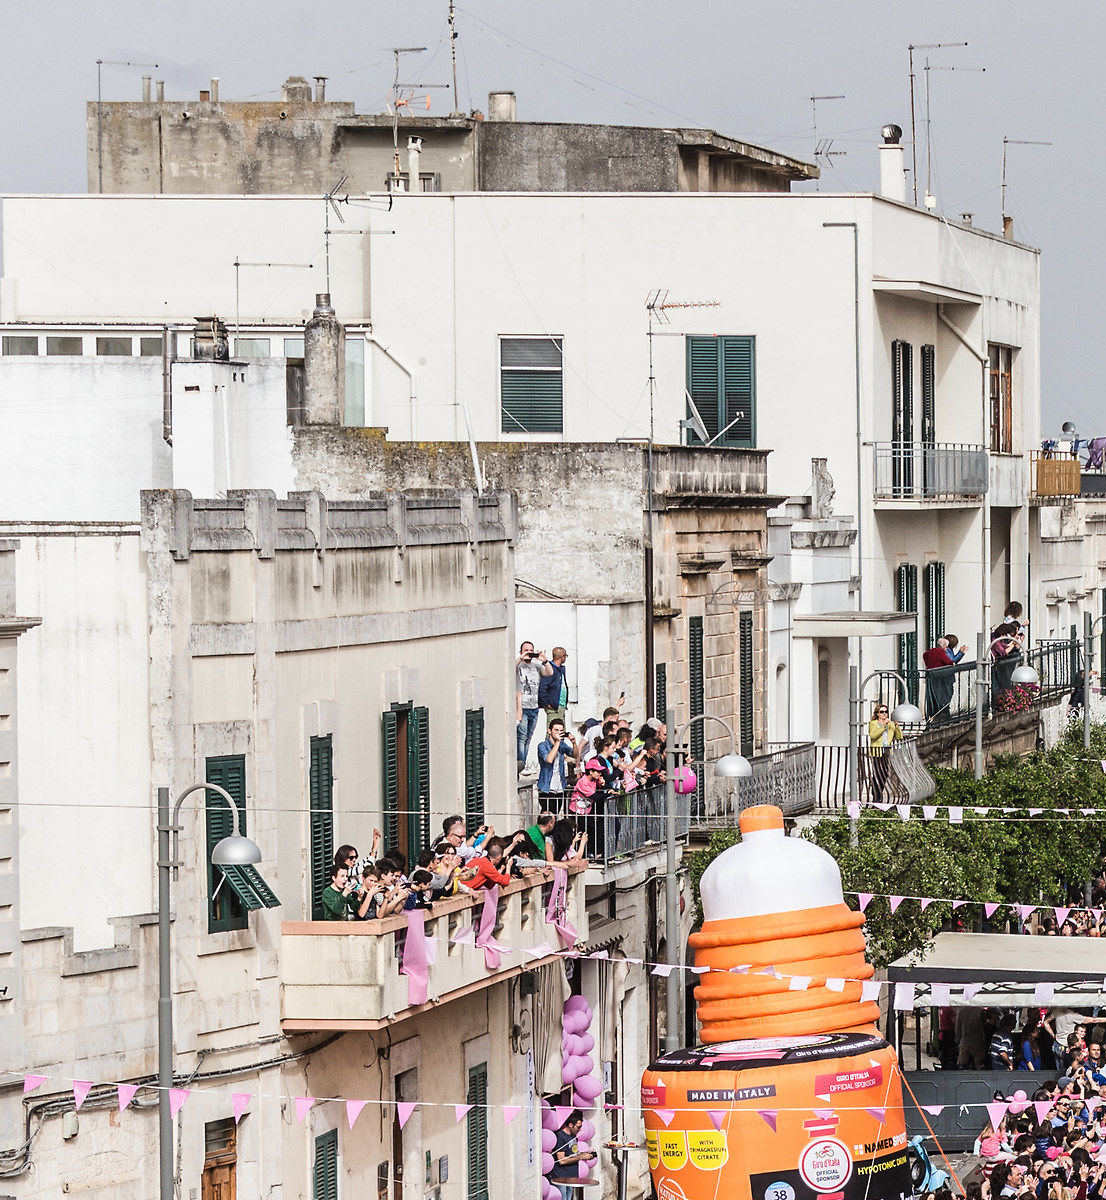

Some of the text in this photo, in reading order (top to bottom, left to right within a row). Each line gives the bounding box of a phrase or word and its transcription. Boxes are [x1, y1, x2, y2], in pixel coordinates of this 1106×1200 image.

[829, 1078, 876, 1092] OFFICIAL SPONSOR
[691, 1087, 771, 1100] MADE IN ITALY
[857, 1159, 897, 1176] HYPOTONIC
[816, 1175, 840, 1183] SPONSOR
[773, 1189, 788, 1200] 38
